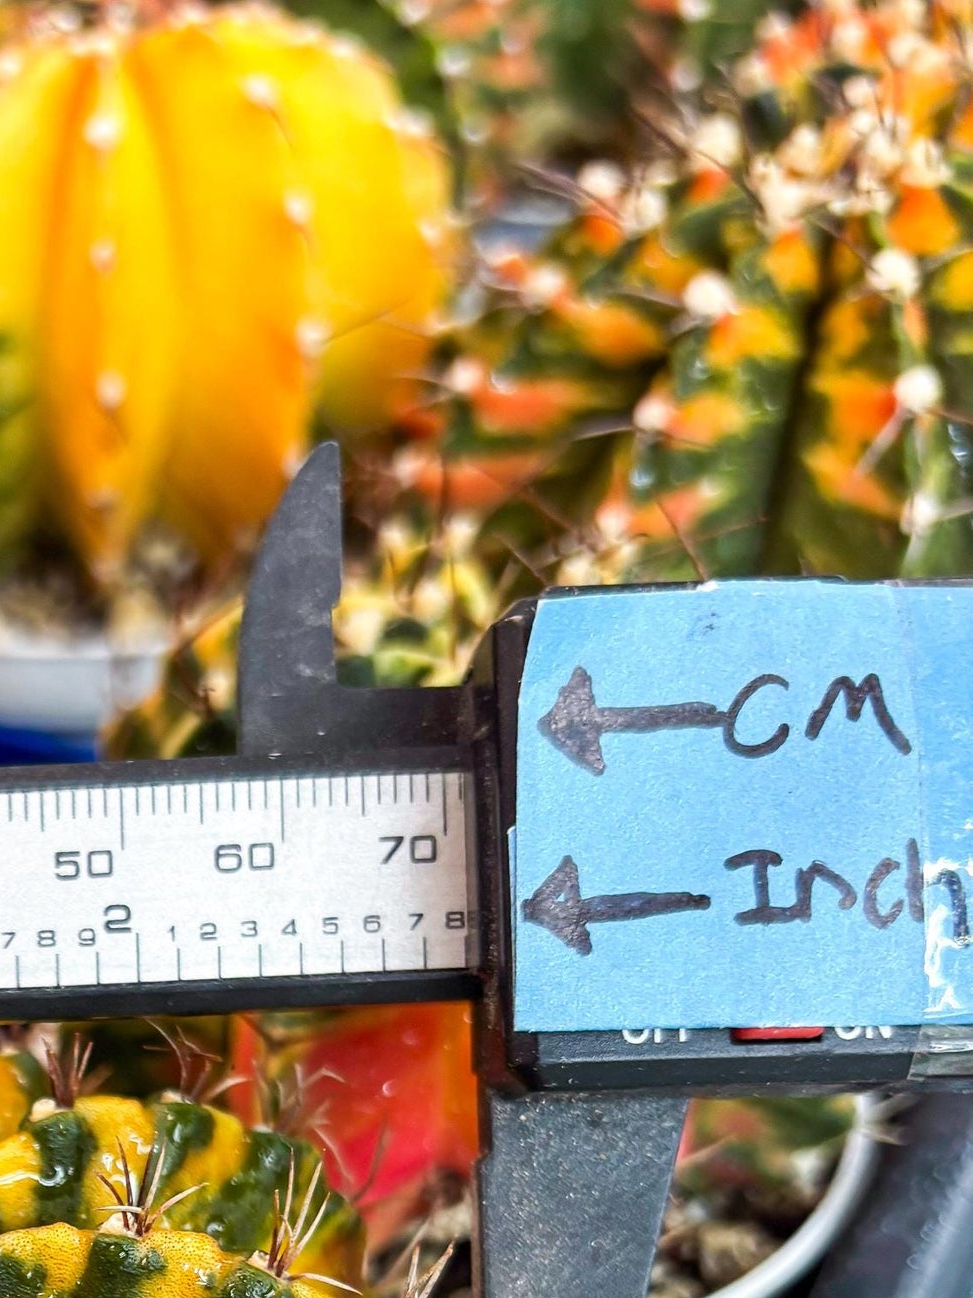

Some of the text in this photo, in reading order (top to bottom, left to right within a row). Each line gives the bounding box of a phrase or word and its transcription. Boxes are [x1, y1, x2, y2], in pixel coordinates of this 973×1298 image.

[54, 849, 114, 881] 50
[214, 842, 276, 873] 60
[379, 834, 437, 865] 70
[724, 837, 970, 947] Inch
[1, 931, 17, 950] 7
[36, 929, 57, 948] 8
[77, 927, 97, 948] 9
[103, 903, 133, 934] 2
[167, 925, 176, 942] 1
[199, 922, 218, 941] 2
[240, 920, 259, 938] 3
[281, 918, 298, 937] 4
[322, 916, 339, 935] 5
[363, 914, 382, 934] 6
[408, 912, 425, 931] 7
[445, 910, 465, 930] 8
